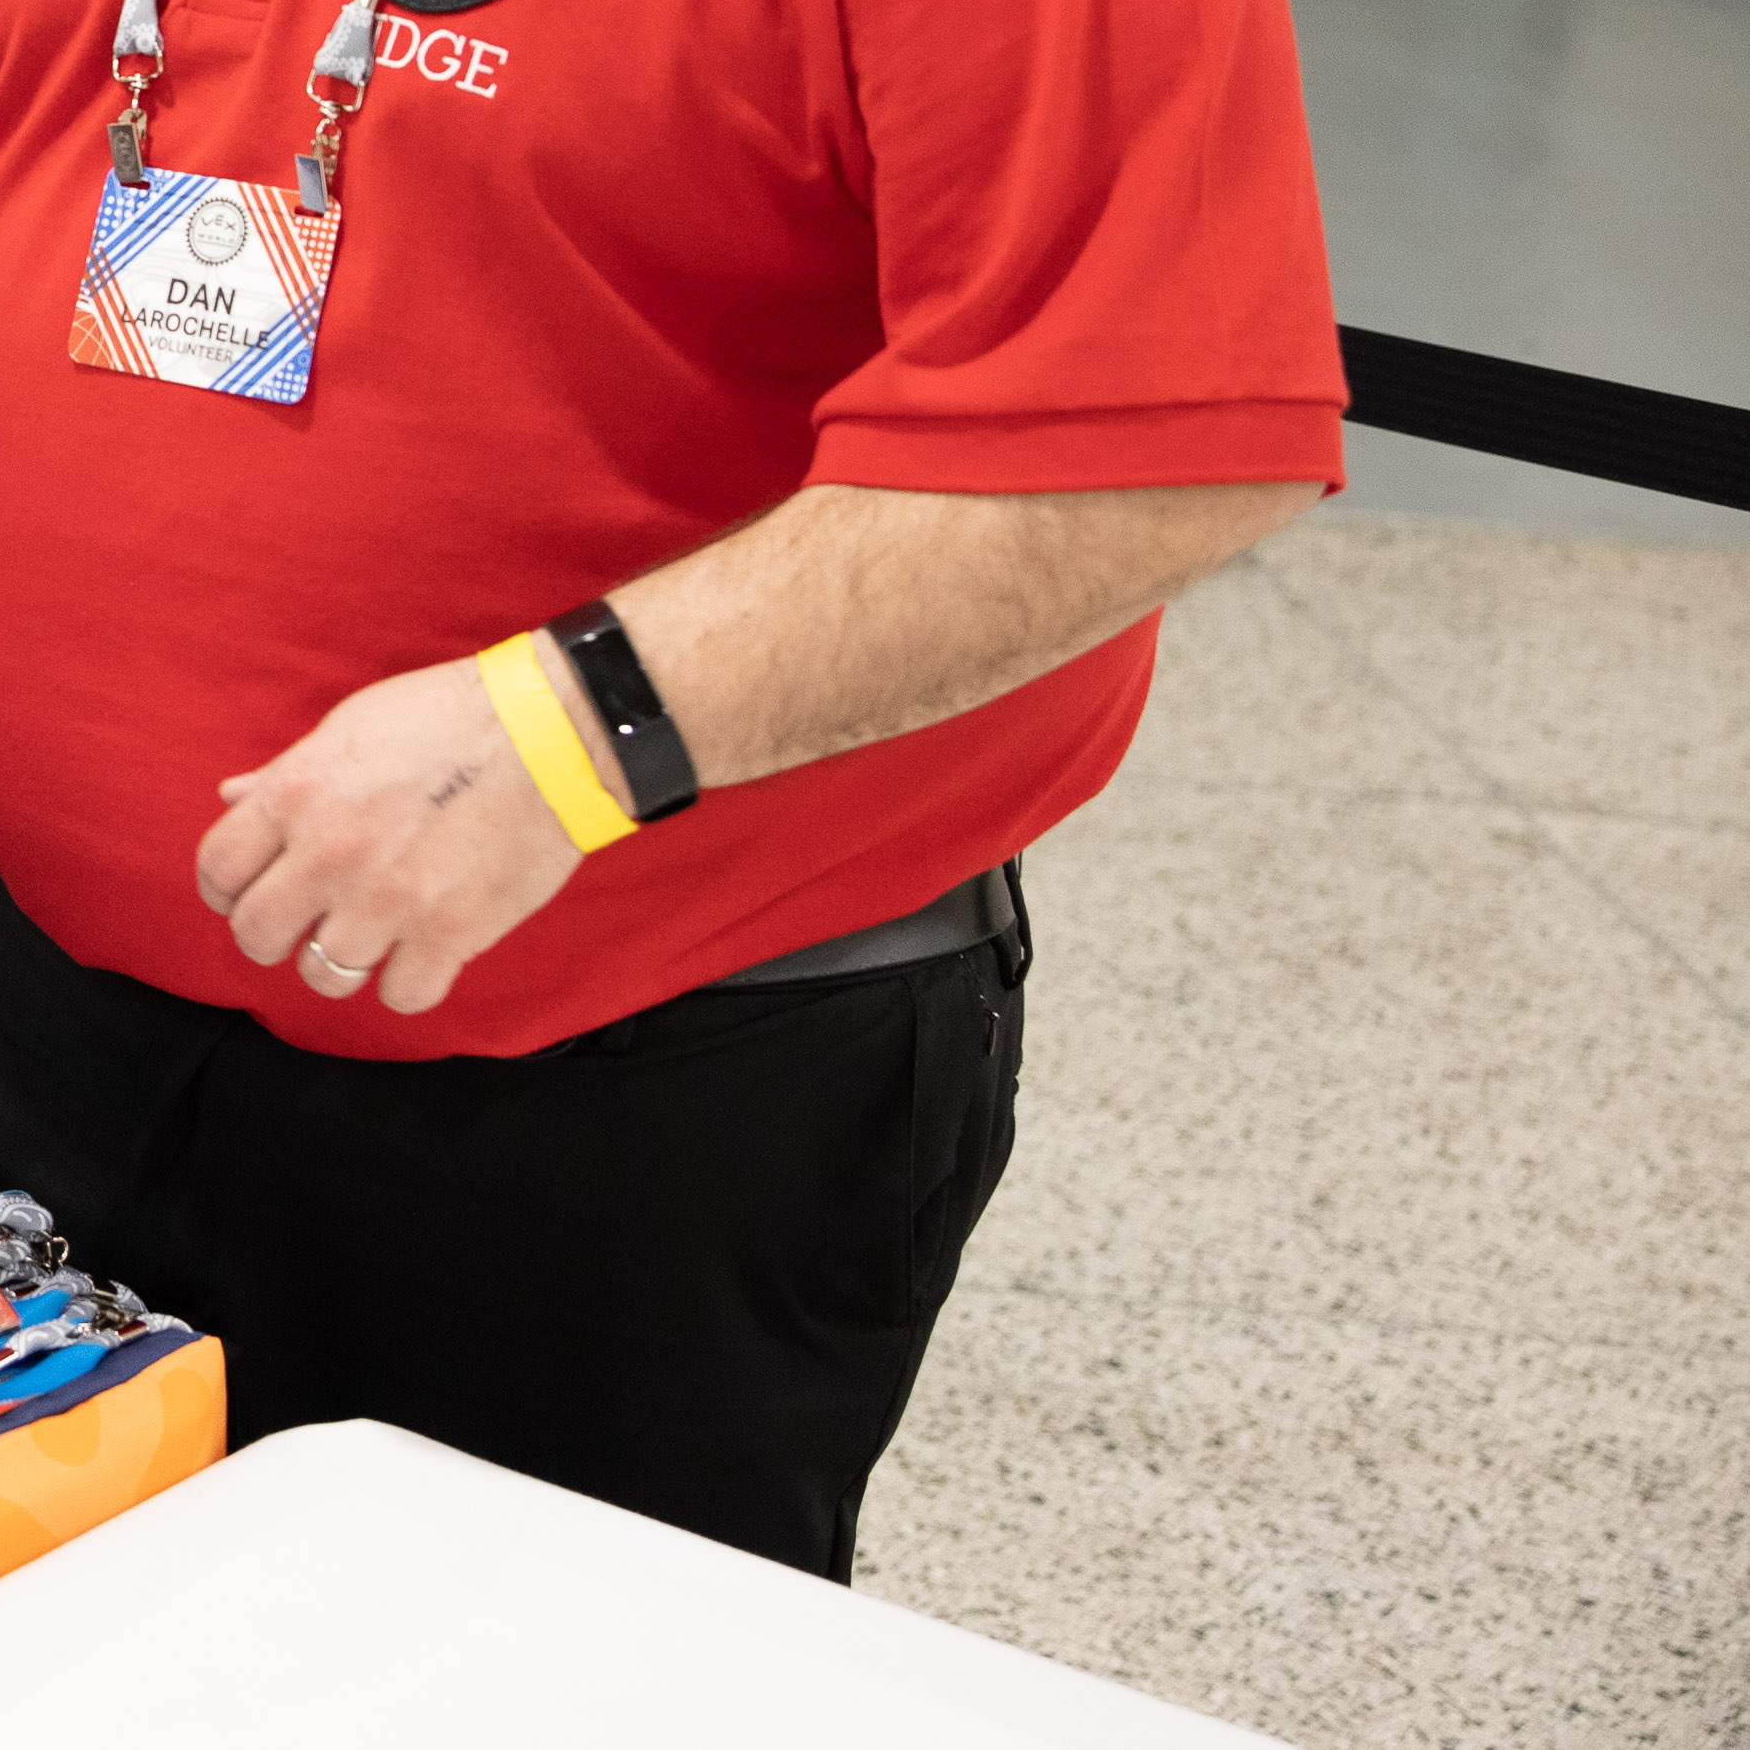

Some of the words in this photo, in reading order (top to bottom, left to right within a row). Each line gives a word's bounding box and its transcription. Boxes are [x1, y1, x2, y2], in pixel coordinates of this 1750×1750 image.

[376, 13, 509, 99] DGE
[201, 214, 236, 232] VEX
[167, 278, 236, 315] DAN
[121, 304, 270, 351] LAROCHELLE
[149, 335, 235, 364] VOLUNTEER
